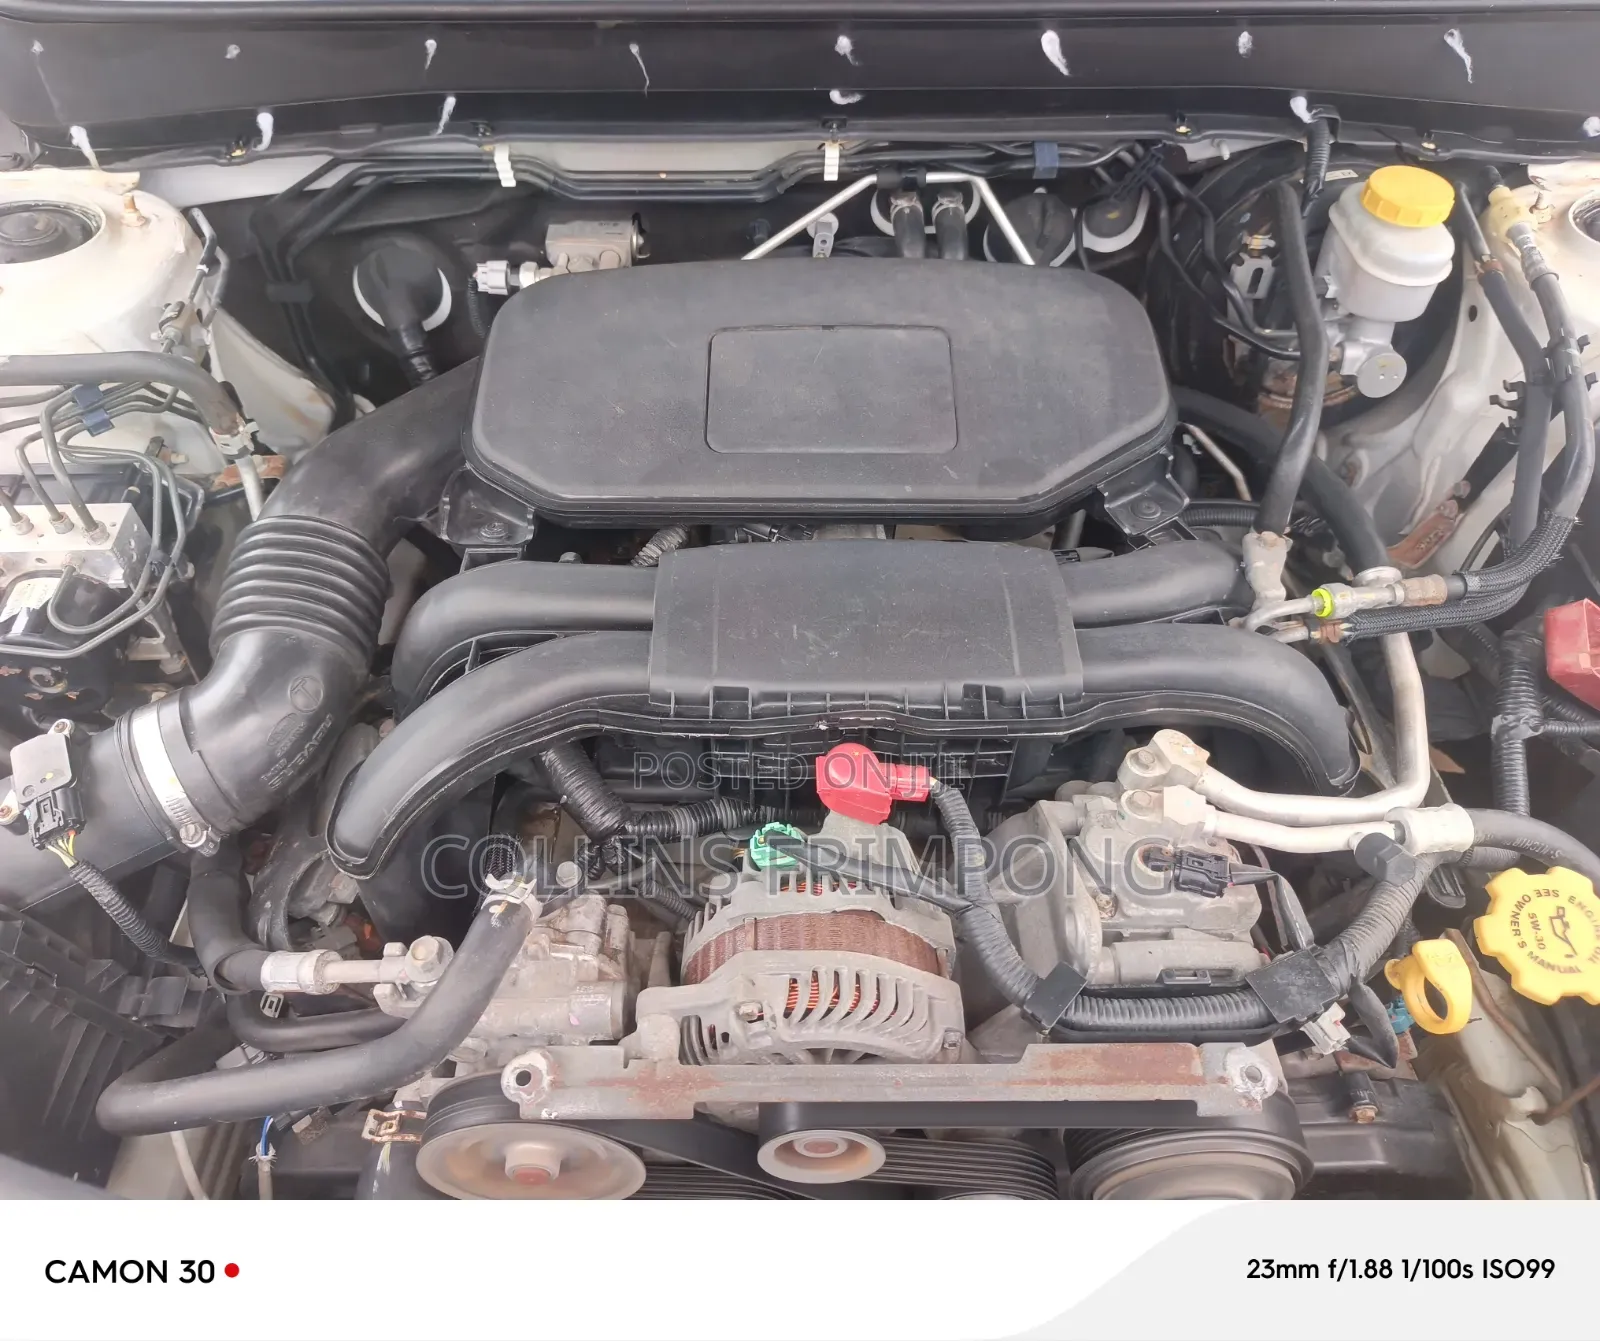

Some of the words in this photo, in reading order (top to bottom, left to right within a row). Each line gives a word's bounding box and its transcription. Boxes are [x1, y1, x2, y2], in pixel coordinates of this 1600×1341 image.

[1534, 888, 1560, 898] SEE
[1510, 894, 1532, 949] OWNER'S
[1527, 951, 1582, 974] MANUAL
